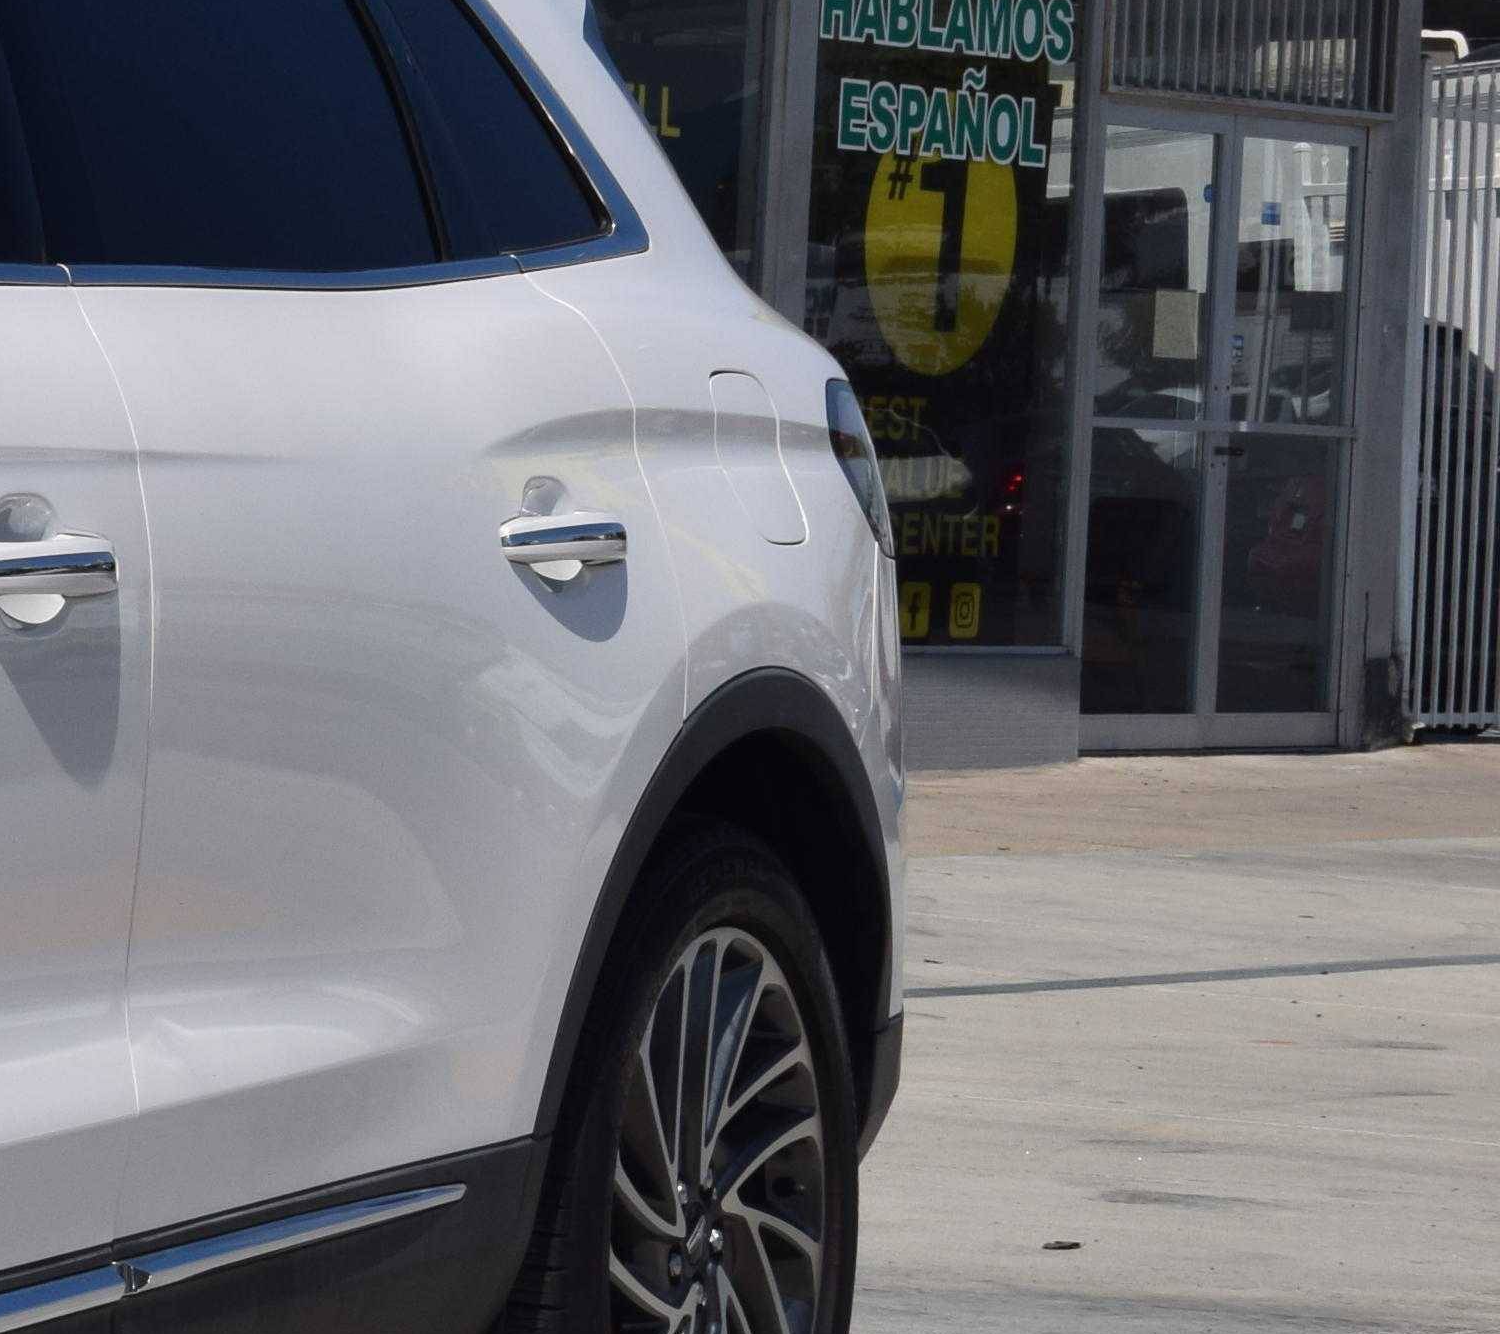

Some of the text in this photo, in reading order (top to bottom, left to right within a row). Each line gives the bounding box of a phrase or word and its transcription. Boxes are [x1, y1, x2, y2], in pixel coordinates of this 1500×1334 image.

[837, 65, 1047, 168] ESPAÑOL
[864, 395, 930, 443] EST
[891, 513, 1000, 557] ENTER
